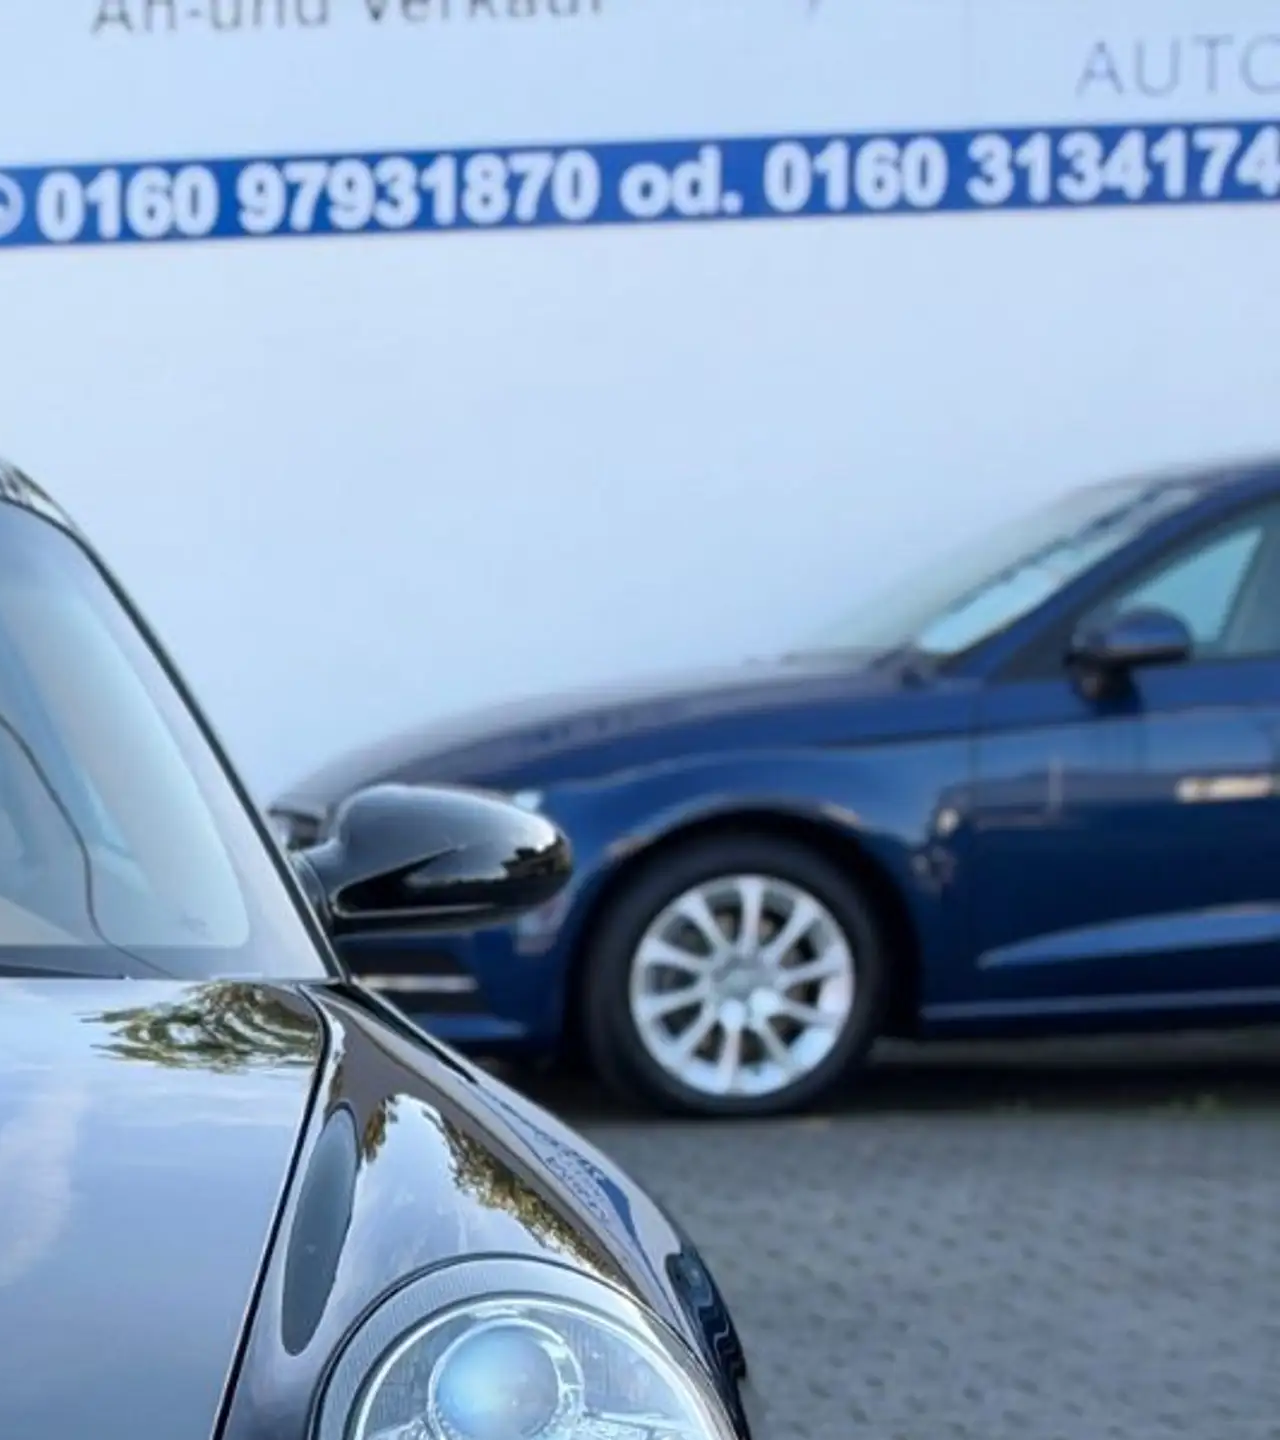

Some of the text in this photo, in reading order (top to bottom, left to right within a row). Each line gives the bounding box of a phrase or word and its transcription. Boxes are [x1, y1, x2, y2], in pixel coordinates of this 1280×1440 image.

[37, 127, 1280, 242] 0160 97931870 od. 0160 3134174
